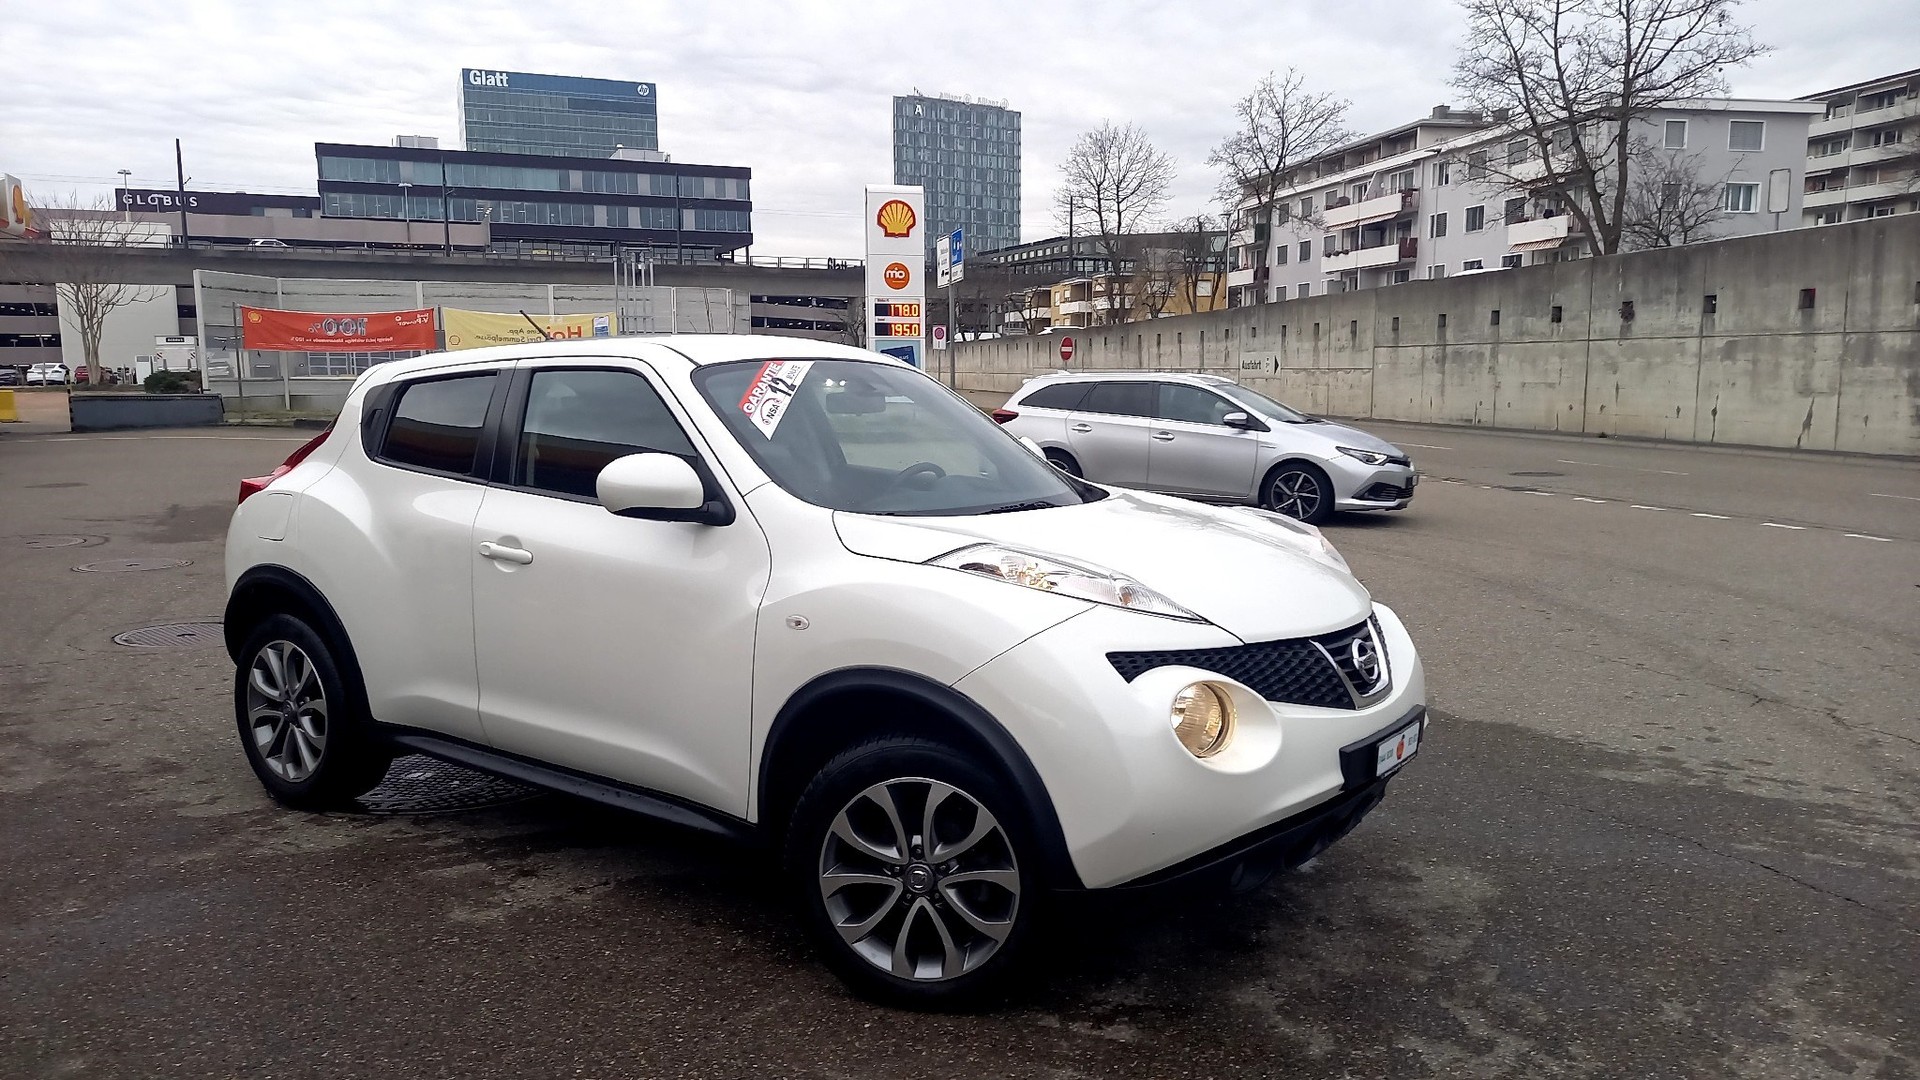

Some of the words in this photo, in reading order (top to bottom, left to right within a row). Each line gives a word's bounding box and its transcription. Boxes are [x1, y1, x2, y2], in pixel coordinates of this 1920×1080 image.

[469, 69, 508, 87] Glatt
[122, 193, 198, 207] GLOBUS
[885, 266, 905, 279] mio
[1241, 360, 1261, 370] Ausfahrt
[742, 362, 782, 413] GARANTIE
[768, 377, 797, 397] 12
[766, 404, 780, 420] NSA
